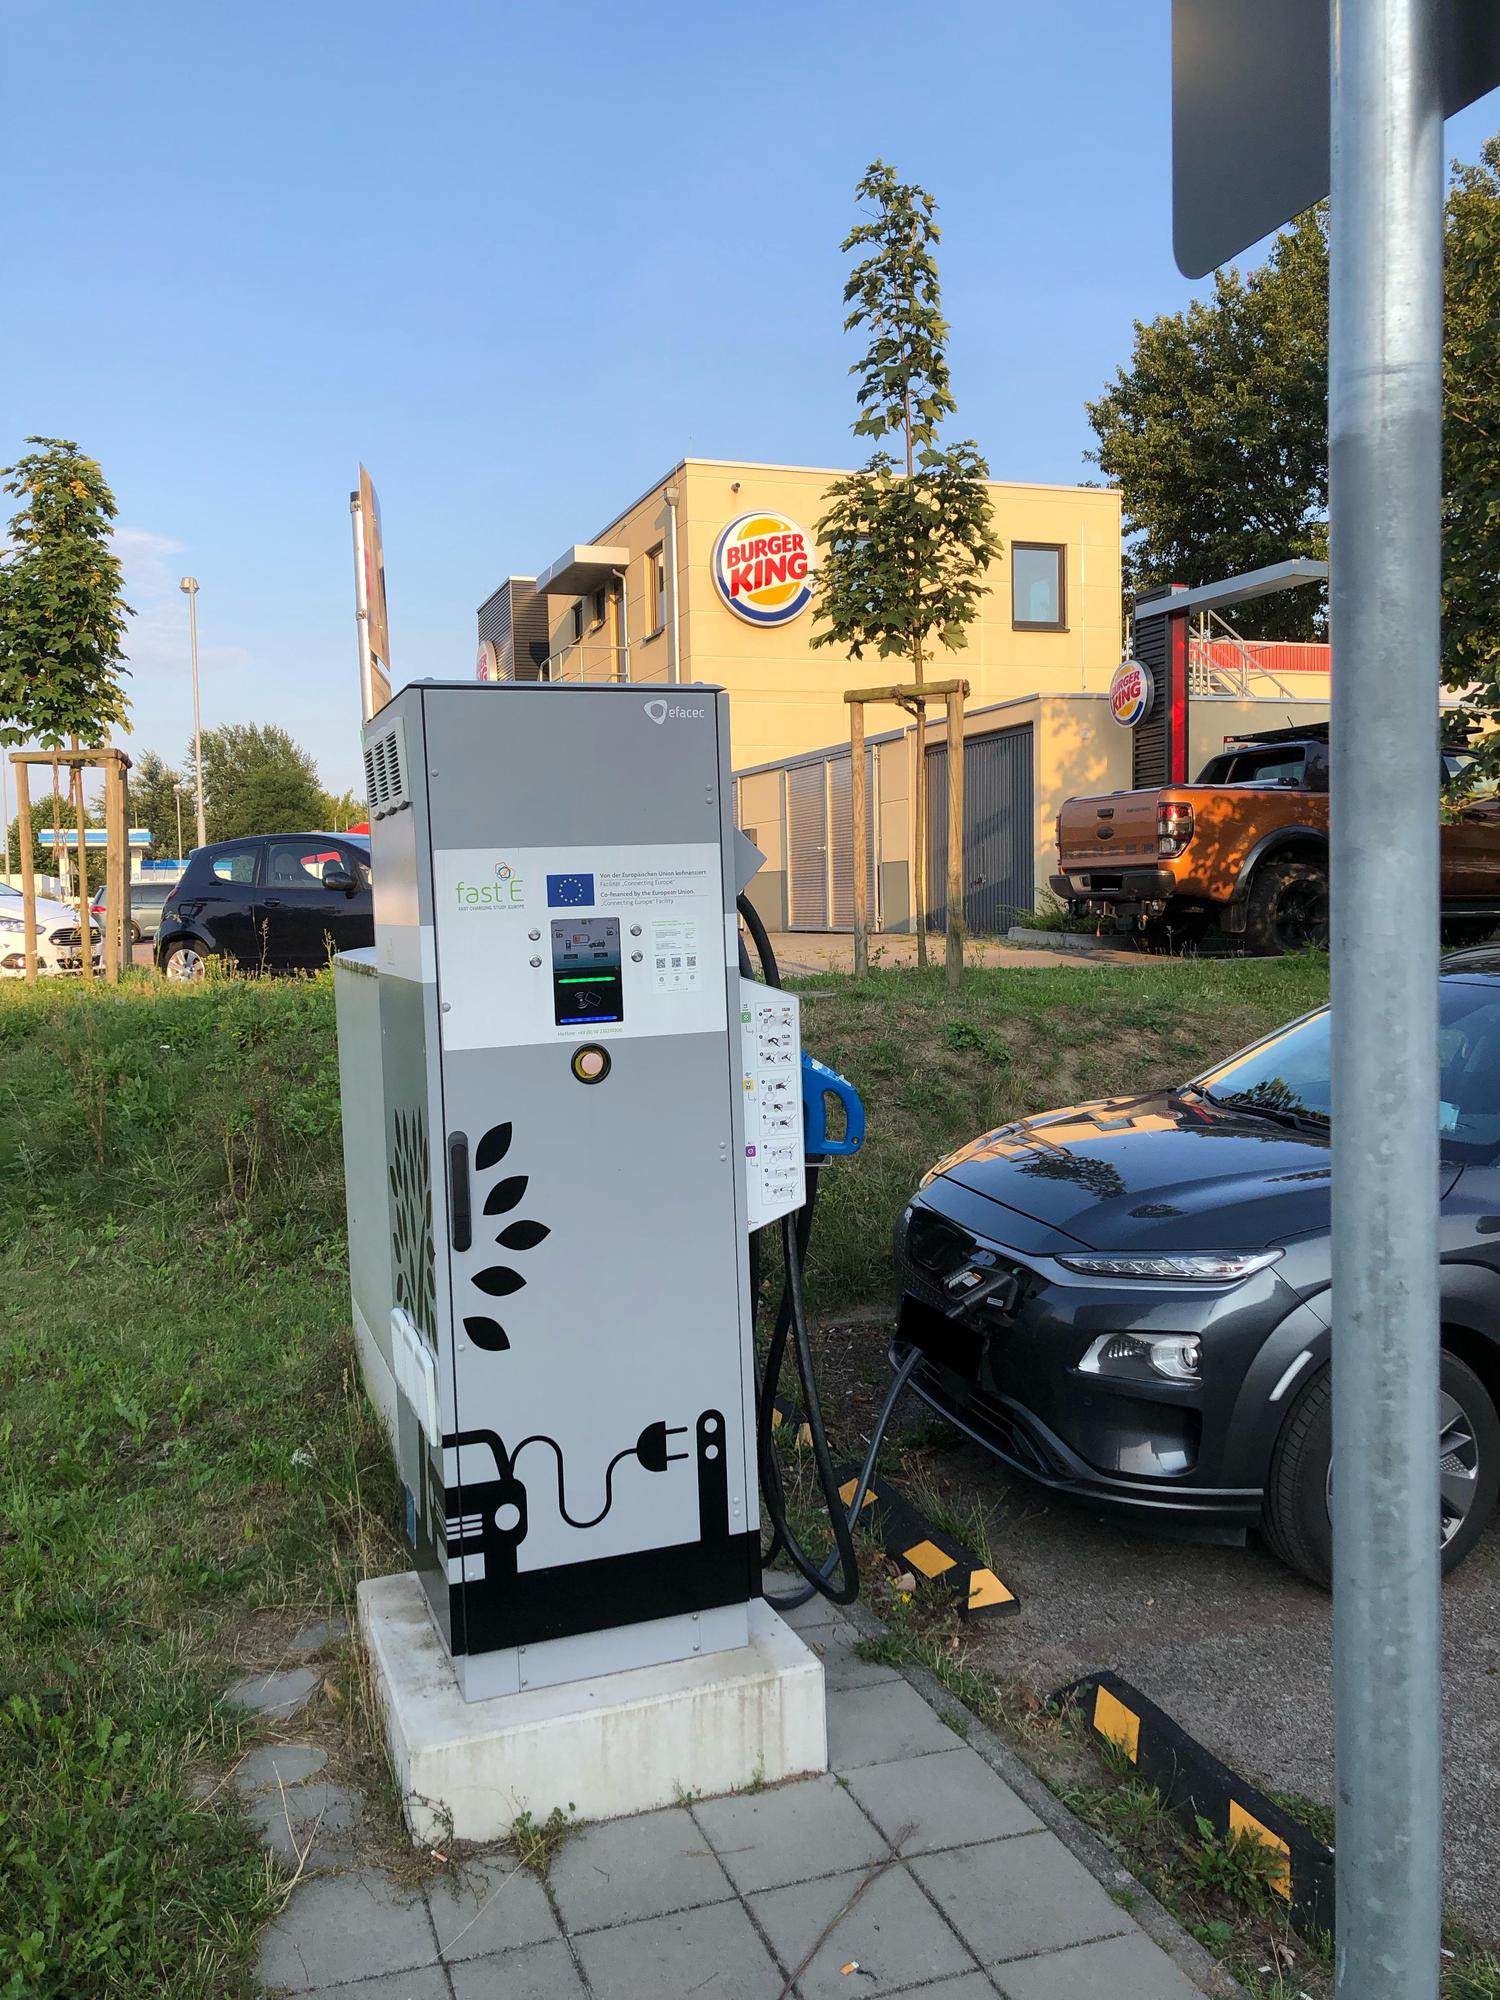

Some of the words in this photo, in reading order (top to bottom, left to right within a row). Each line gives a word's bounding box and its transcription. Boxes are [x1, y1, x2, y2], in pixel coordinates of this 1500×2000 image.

[727, 533, 804, 569] BURGER
[730, 552, 808, 598] KING
[1112, 670, 1140, 695] BURGER
[1111, 681, 1141, 716] KING
[669, 705, 705, 718] efacec
[622, 871, 657, 879] Europäischen
[456, 881, 503, 904] fast
[510, 880, 525, 902] E
[633, 890, 641, 898] by
